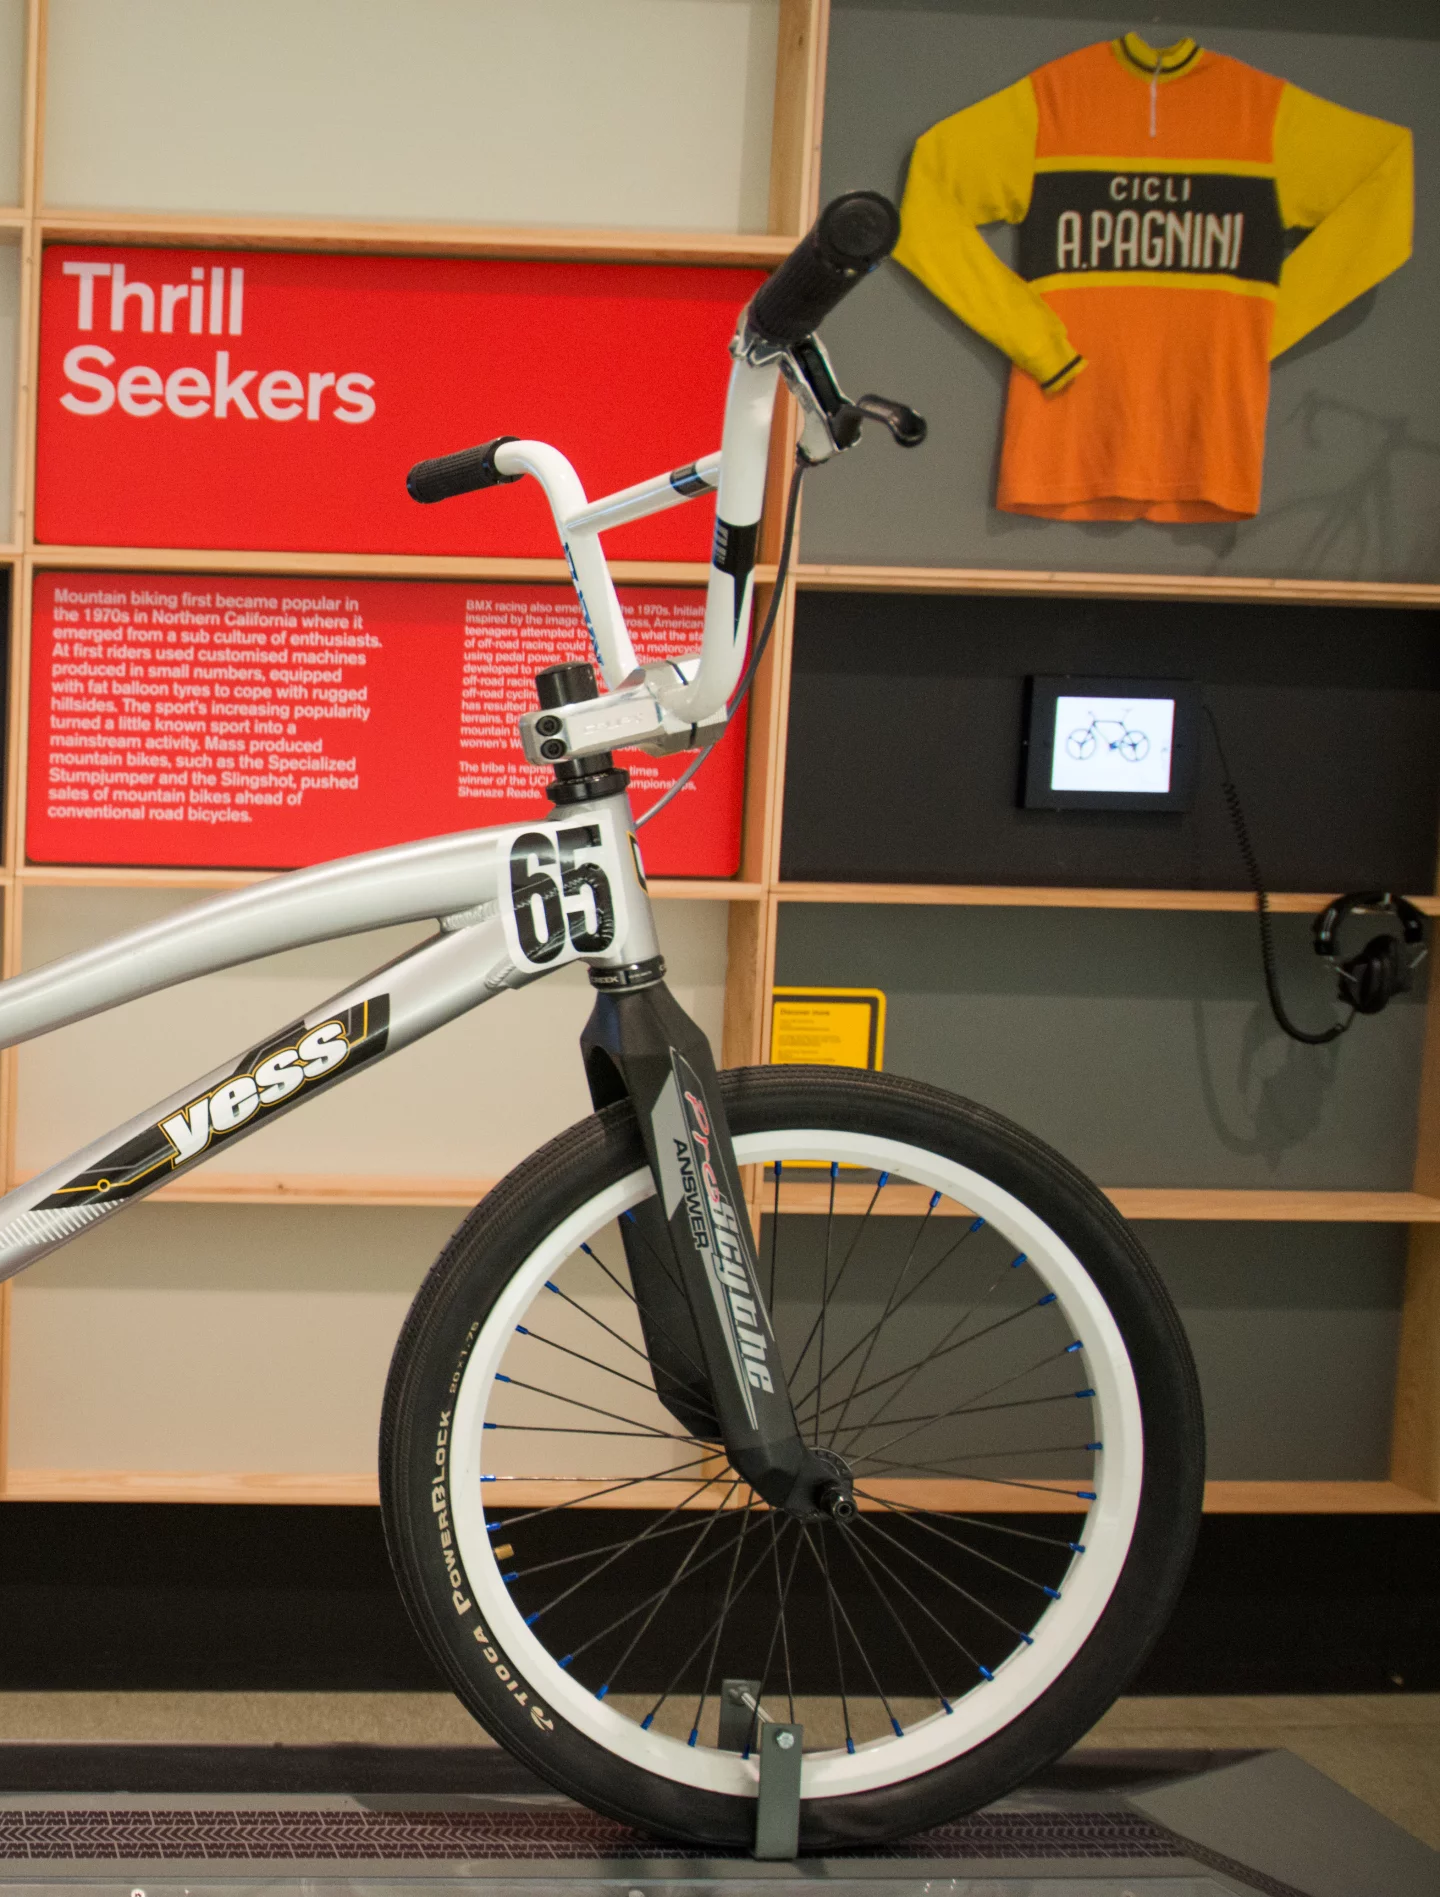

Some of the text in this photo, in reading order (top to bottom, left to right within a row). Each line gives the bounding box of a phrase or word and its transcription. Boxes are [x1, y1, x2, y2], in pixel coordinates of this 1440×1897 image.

[1110, 177, 1191, 202] CICLI
[1057, 209, 1244, 270] A.PAGNINI
[62, 261, 245, 336] Thrill
[60, 345, 376, 424] Seekers
[54, 589, 360, 613] Mountain biking first became popular in
[466, 600, 671, 616] BMX racing also 1970s.
[53, 607, 364, 629] the 1970s in Northern California where it
[465, 612, 509, 628] inspired
[509, 613, 524, 628] by
[525, 613, 544, 626] the
[545, 614, 579, 629] image
[52, 625, 383, 647] emerged from a sub culture of enthusiasts.
[464, 625, 519, 640] teenagers
[519, 626, 575, 641] attempted
[576, 627, 588, 639] to
[640, 628, 667, 641] what
[668, 629, 687, 641] the
[52, 643, 367, 664] At first riders used customised machines
[463, 637, 476, 649] of
[477, 637, 520, 650] off-road
[521, 638, 555, 653] racing
[555, 639, 587, 651] could
[463, 649, 494, 664] using
[495, 650, 526, 665] pedal
[527, 653, 563, 666] power.
[565, 651, 587, 664] The
[51, 660, 343, 684] produced in small numbers, equipped
[462, 662, 519, 677] developed
[520, 663, 532, 675] to
[51, 678, 368, 703] with fat balloon tyres to cope with rugged
[462, 674, 537, 690] off-road racing
[461, 687, 538, 703] off-road cycling
[461, 699, 527, 712] has resulted
[50, 696, 371, 721] hillsides. The sport's increasing popularity
[460, 711, 503, 724] terrains.
[49, 714, 297, 736] turned a little known sport into a
[460, 724, 511, 737] mountain
[49, 732, 323, 755] mainstream activity. Mass produced
[459, 736, 508, 749] women's
[49, 750, 357, 774] mountain bikes, such as the Specialized
[459, 761, 659, 777] The tribe is times
[49, 767, 359, 792] Stumpjumper and the Slingshot, pushed
[458, 774, 494, 786] winner
[495, 774, 508, 787] of
[508, 775, 527, 787] the
[528, 775, 549, 787] UCI
[48, 785, 304, 806] sales of mountain bikes ahead of
[457, 786, 542, 800] Shanaze Reade.
[47, 803, 253, 825] conventional road bicycles.
[509, 824, 615, 964] 65
[160, 1019, 349, 1166] yess
[673, 1138, 710, 1250] ANSWER
[471, 1626, 528, 1707] TIOGA
